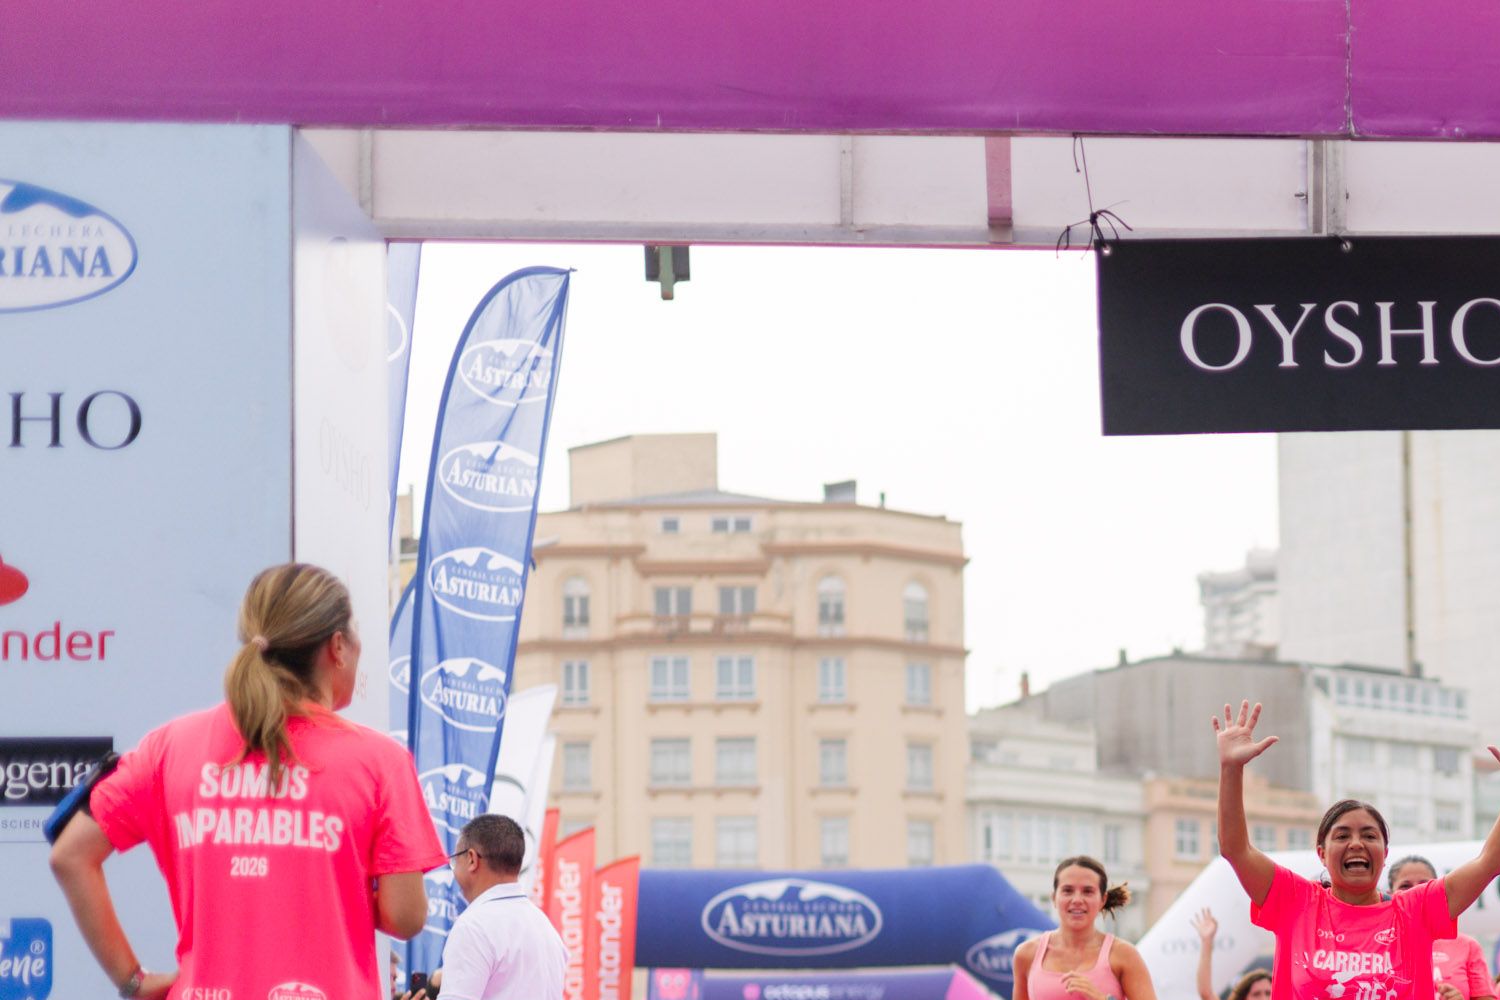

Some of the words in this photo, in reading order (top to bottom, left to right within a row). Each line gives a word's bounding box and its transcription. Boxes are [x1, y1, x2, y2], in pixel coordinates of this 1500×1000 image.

[7, 224, 104, 237] LECHERA
[0, 245, 114, 278] IANA
[467, 352, 551, 389] ASTRN
[8, 390, 142, 450] HO
[1, 620, 115, 661] nder
[0, 761, 92, 799] gena
[199, 762, 309, 800] SOMOS
[423, 780, 475, 819] ASURI
[1, 819, 46, 829] SCIEN
[230, 856, 268, 876] 2026
[717, 901, 869, 937] ASTURIANA
[1161, 935, 1234, 954] OYSO
[1313, 950, 1392, 974] CARRERA
